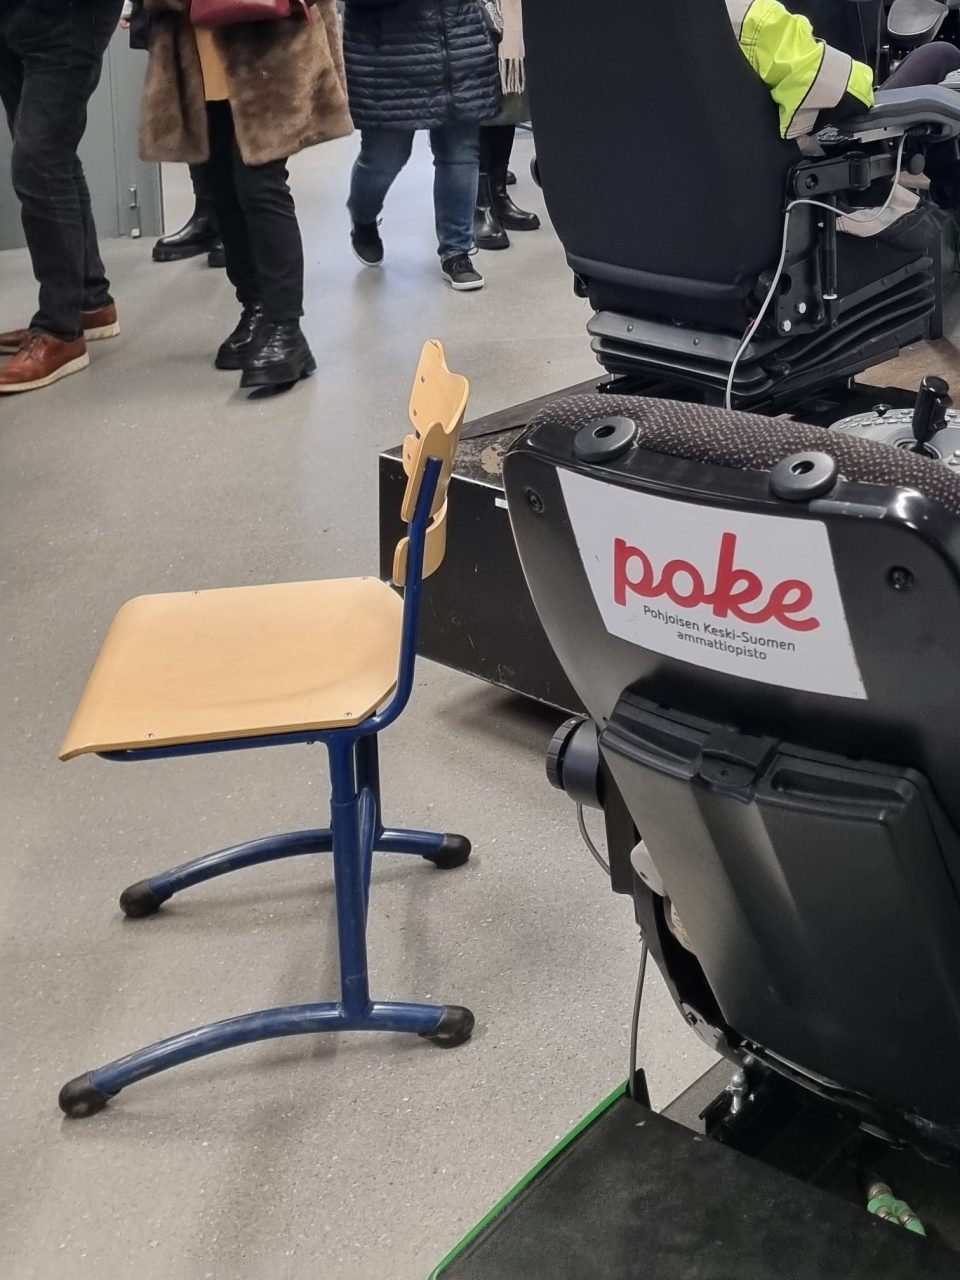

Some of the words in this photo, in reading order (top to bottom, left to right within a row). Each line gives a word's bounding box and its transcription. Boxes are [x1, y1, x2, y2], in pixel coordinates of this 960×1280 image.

[613, 532, 821, 632] poke
[643, 605, 700, 631] Pohjoisen
[703, 622, 796, 652] Keski-Suomen
[677, 631, 767, 660] ammattiopisto
